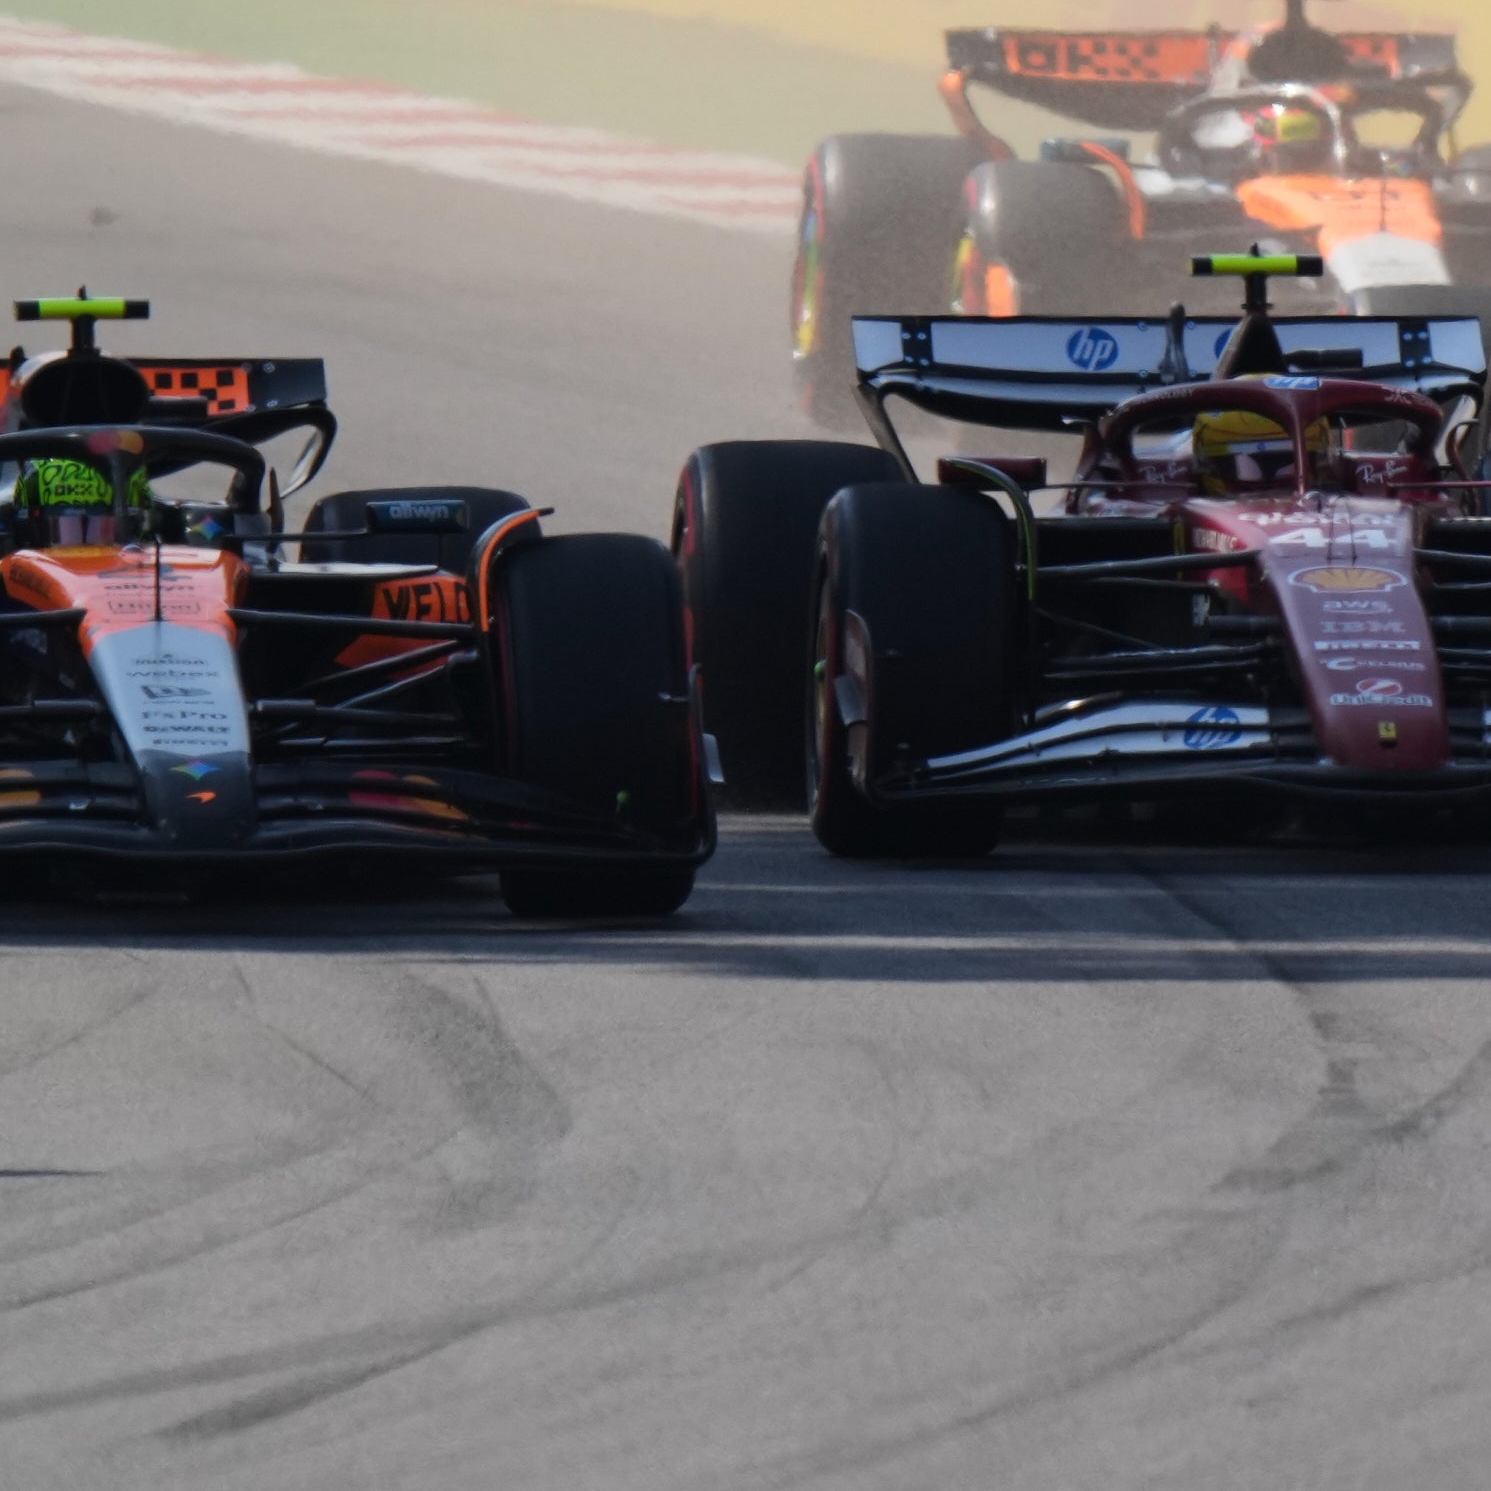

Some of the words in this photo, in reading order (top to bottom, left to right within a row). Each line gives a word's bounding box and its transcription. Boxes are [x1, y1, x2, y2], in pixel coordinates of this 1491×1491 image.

[1072, 327, 1116, 372] hp
[389, 501, 450, 523] allwyn
[1268, 527, 1399, 548] 44
[1319, 620, 1406, 634] IBM
[1193, 708, 1239, 750] hp
